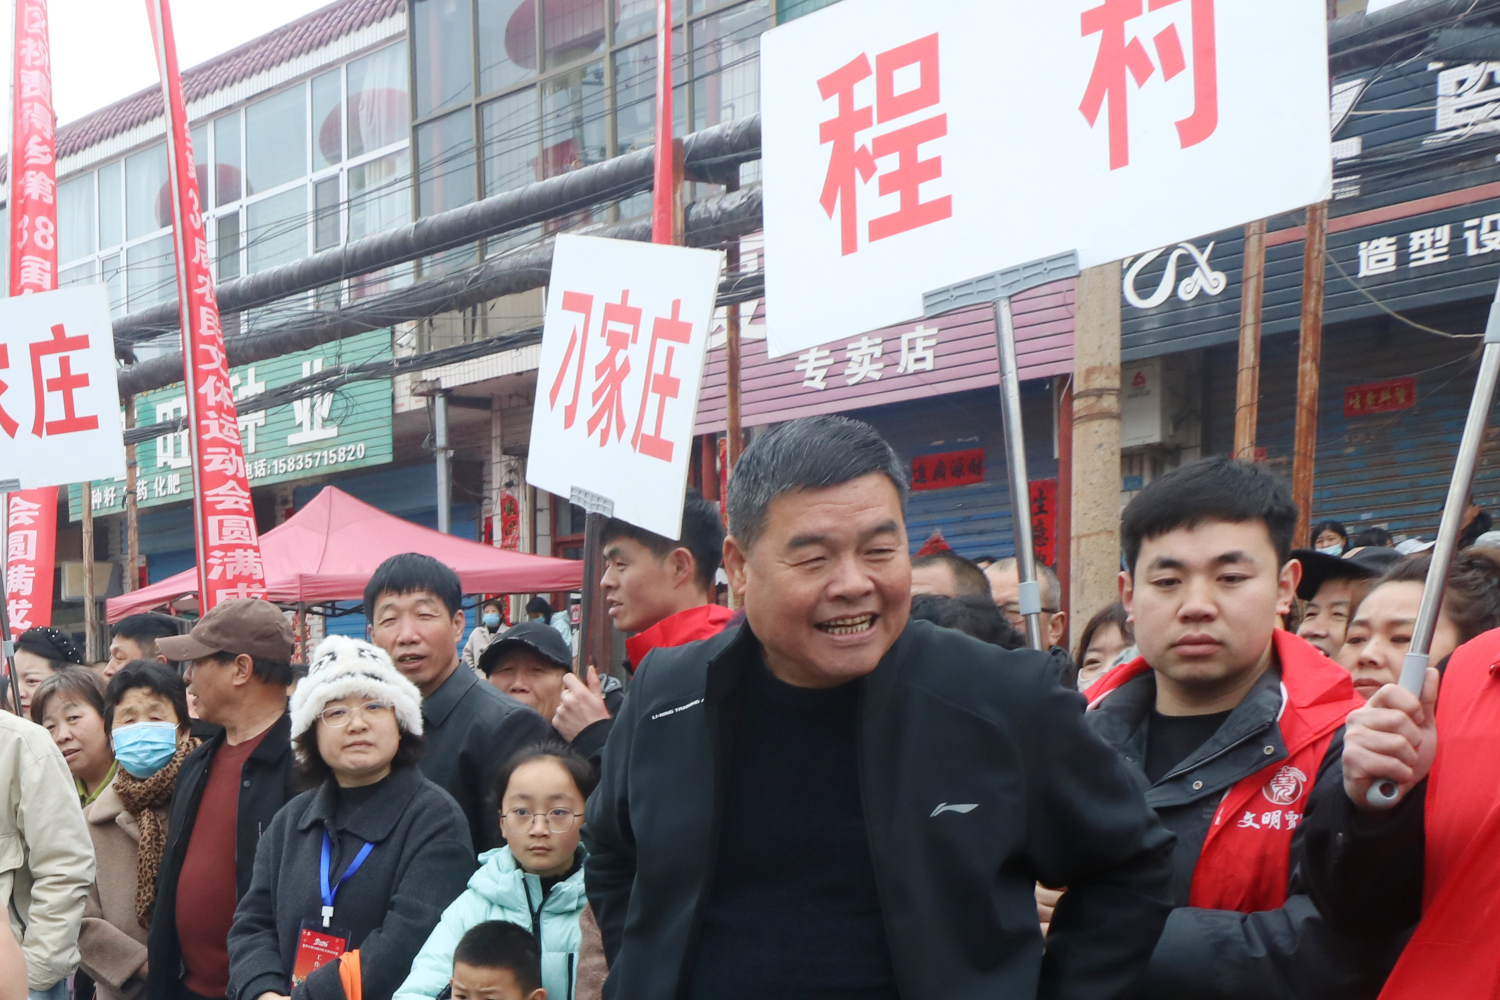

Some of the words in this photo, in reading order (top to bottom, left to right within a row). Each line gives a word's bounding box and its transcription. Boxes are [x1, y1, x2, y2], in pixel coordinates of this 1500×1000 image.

[816, 0, 1221, 257] 程村
[795, 324, 939, 391] 专卖店
[651, 709, 675, 720] LI-NING
[674, 699, 701, 713] TRAINING
[1237, 809, 1304, 831] 文明贾
